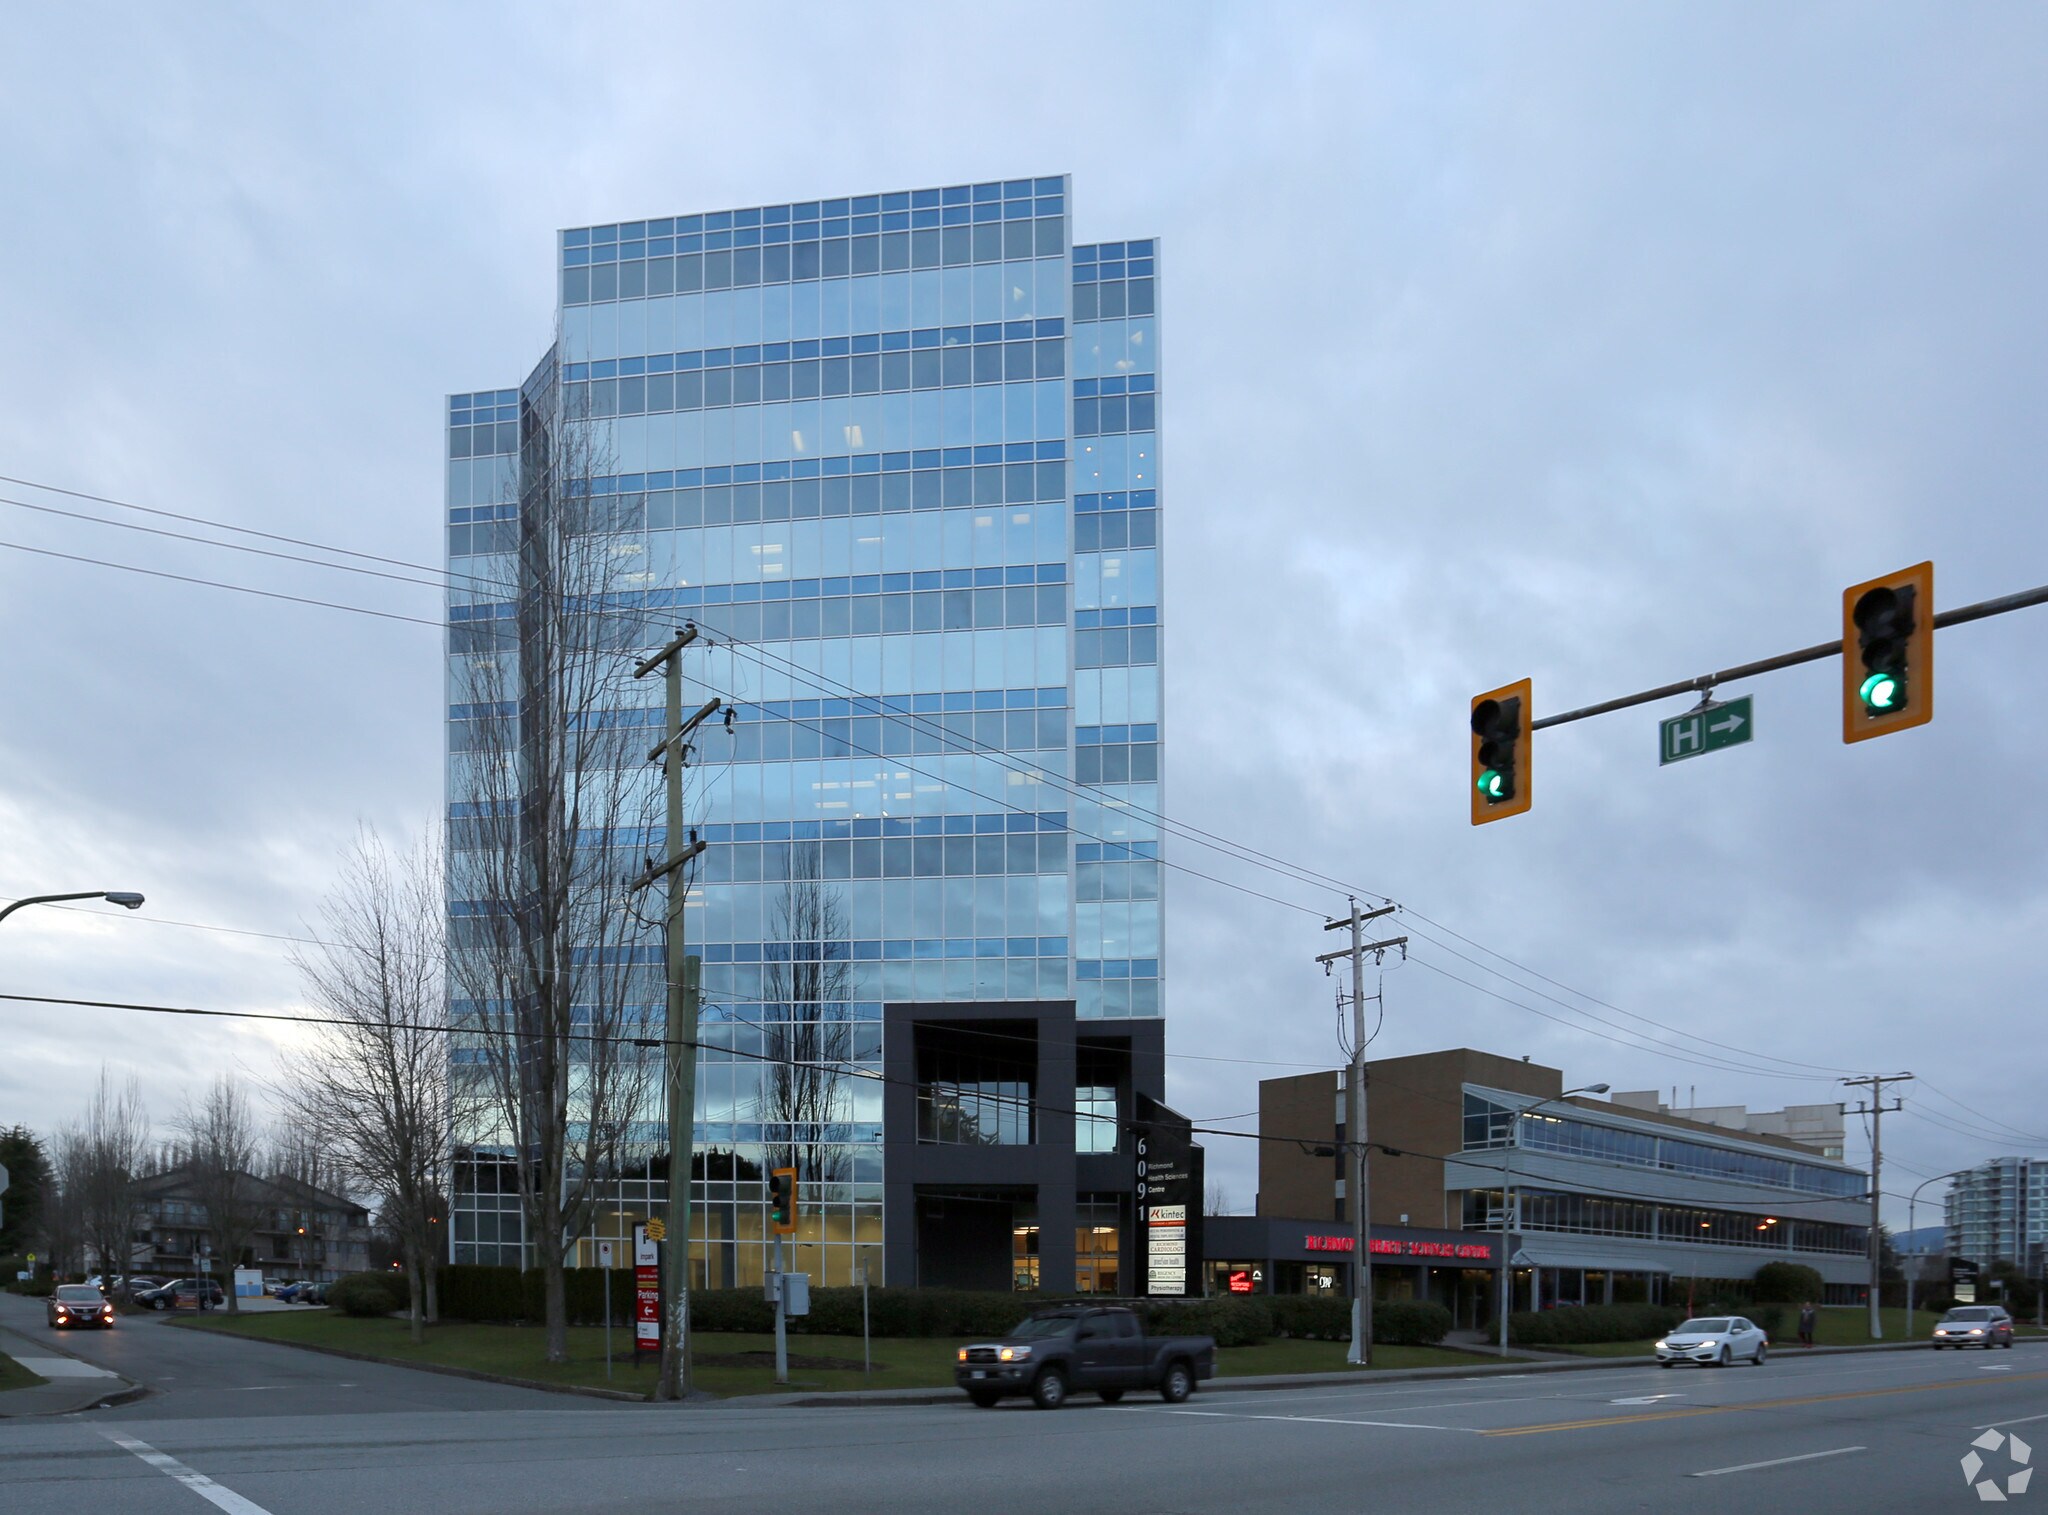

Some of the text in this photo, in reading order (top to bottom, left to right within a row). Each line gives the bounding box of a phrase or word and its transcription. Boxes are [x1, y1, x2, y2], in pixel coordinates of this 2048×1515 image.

[1673, 718, 1699, 754] H
[1137, 1138, 1146, 1221] 6091
[1161, 1209, 1184, 1219] kintec
[638, 1290, 658, 1301] Parking
